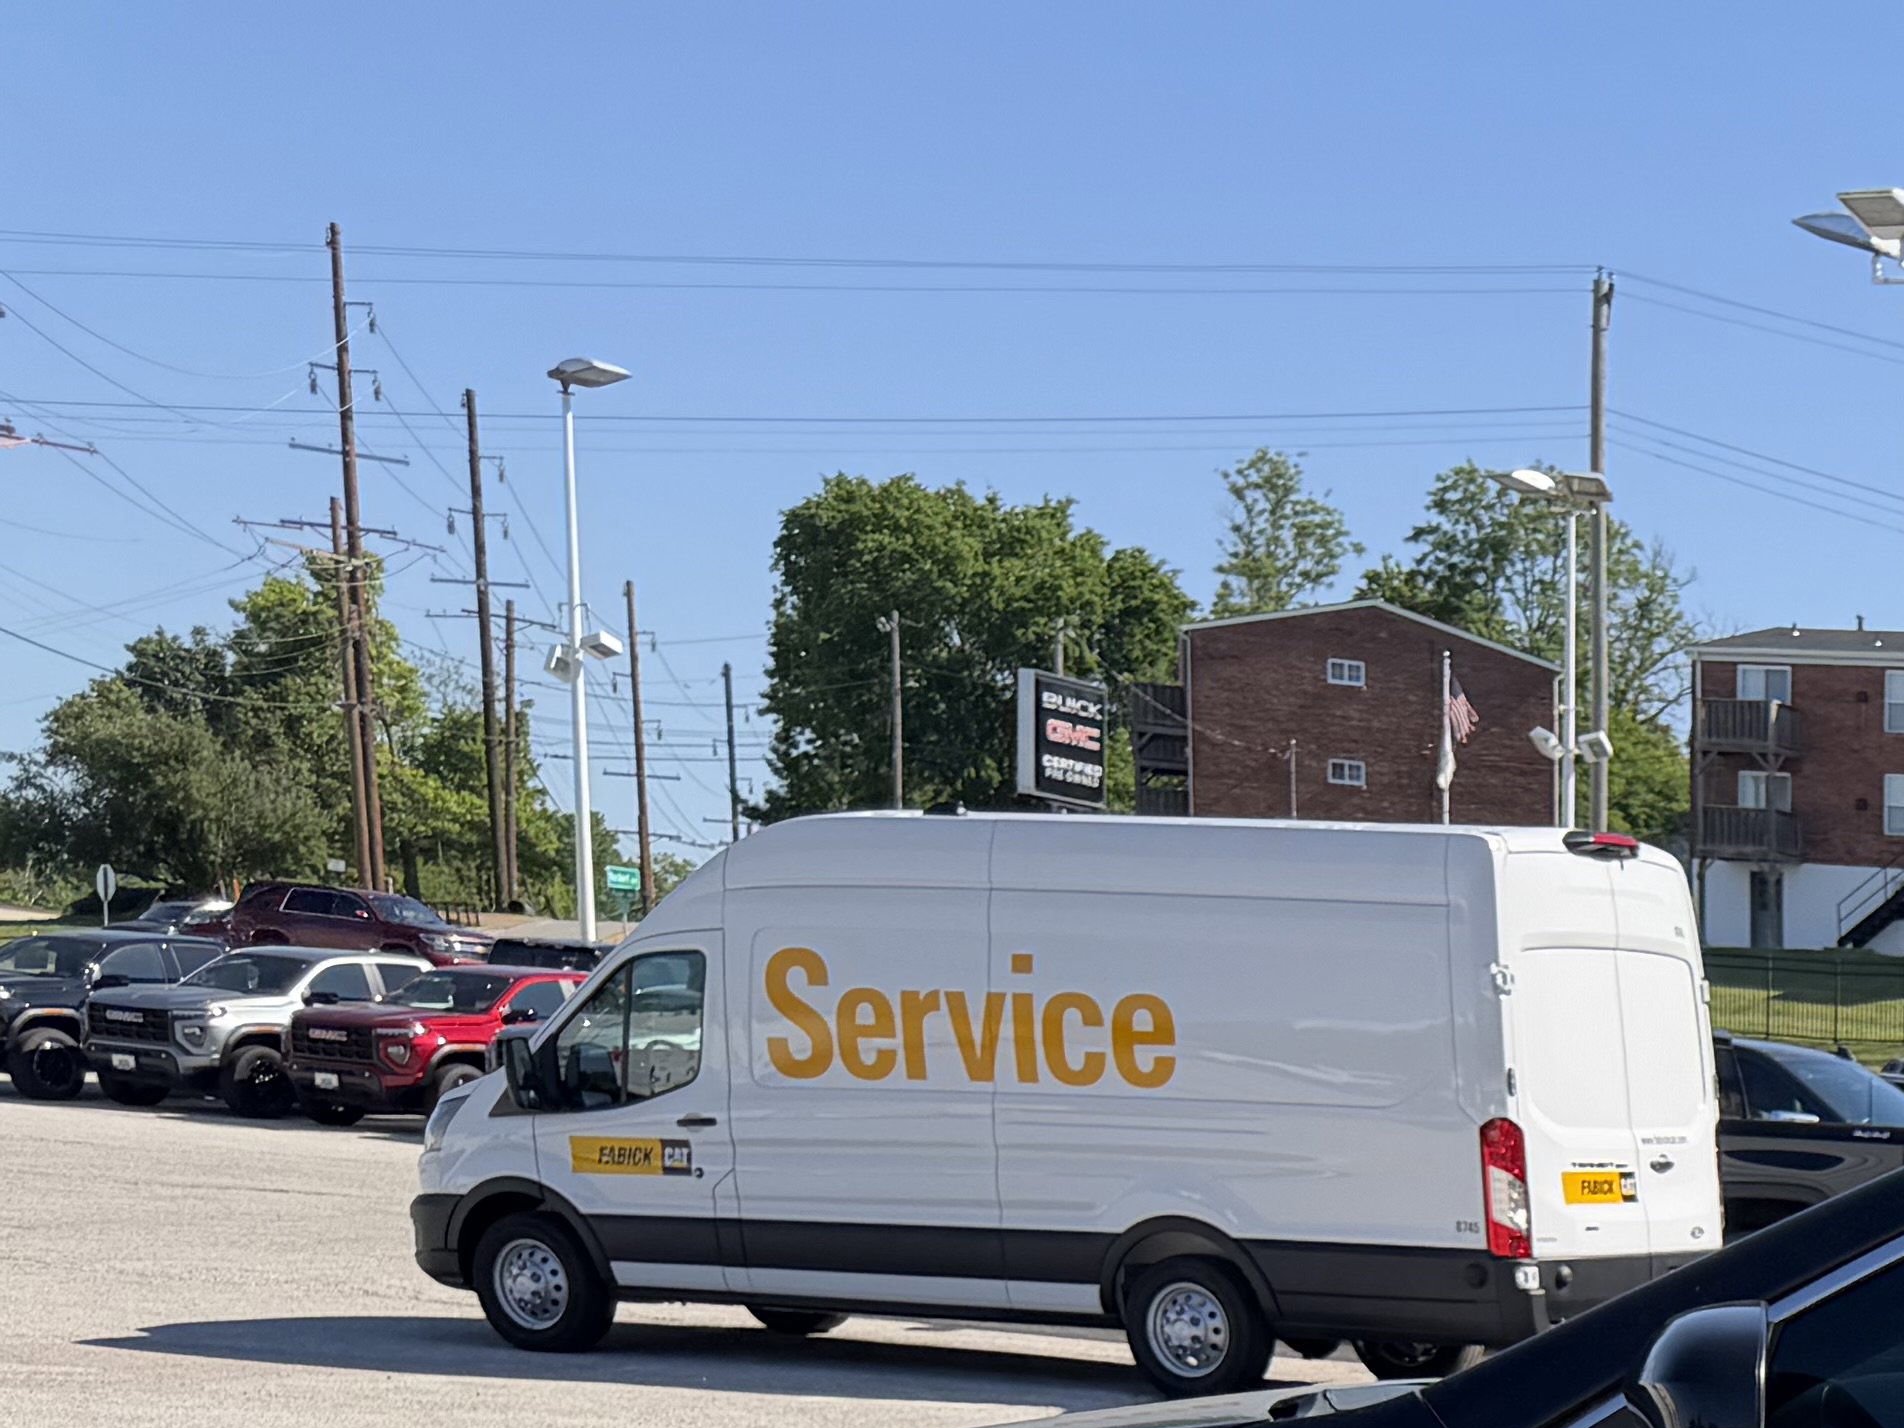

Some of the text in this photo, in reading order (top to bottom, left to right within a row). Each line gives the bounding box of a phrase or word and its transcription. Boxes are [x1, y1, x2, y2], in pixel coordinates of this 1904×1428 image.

[1042, 691, 1103, 720] BUICK
[1046, 718, 1101, 751] GMC
[105, 1009, 144, 1023] GMC
[765, 947, 1176, 1088] Service
[308, 1027, 348, 1042] GMC
[597, 1145, 690, 1168] FABICK CAT
[1580, 1179, 1615, 1196] FABICK
